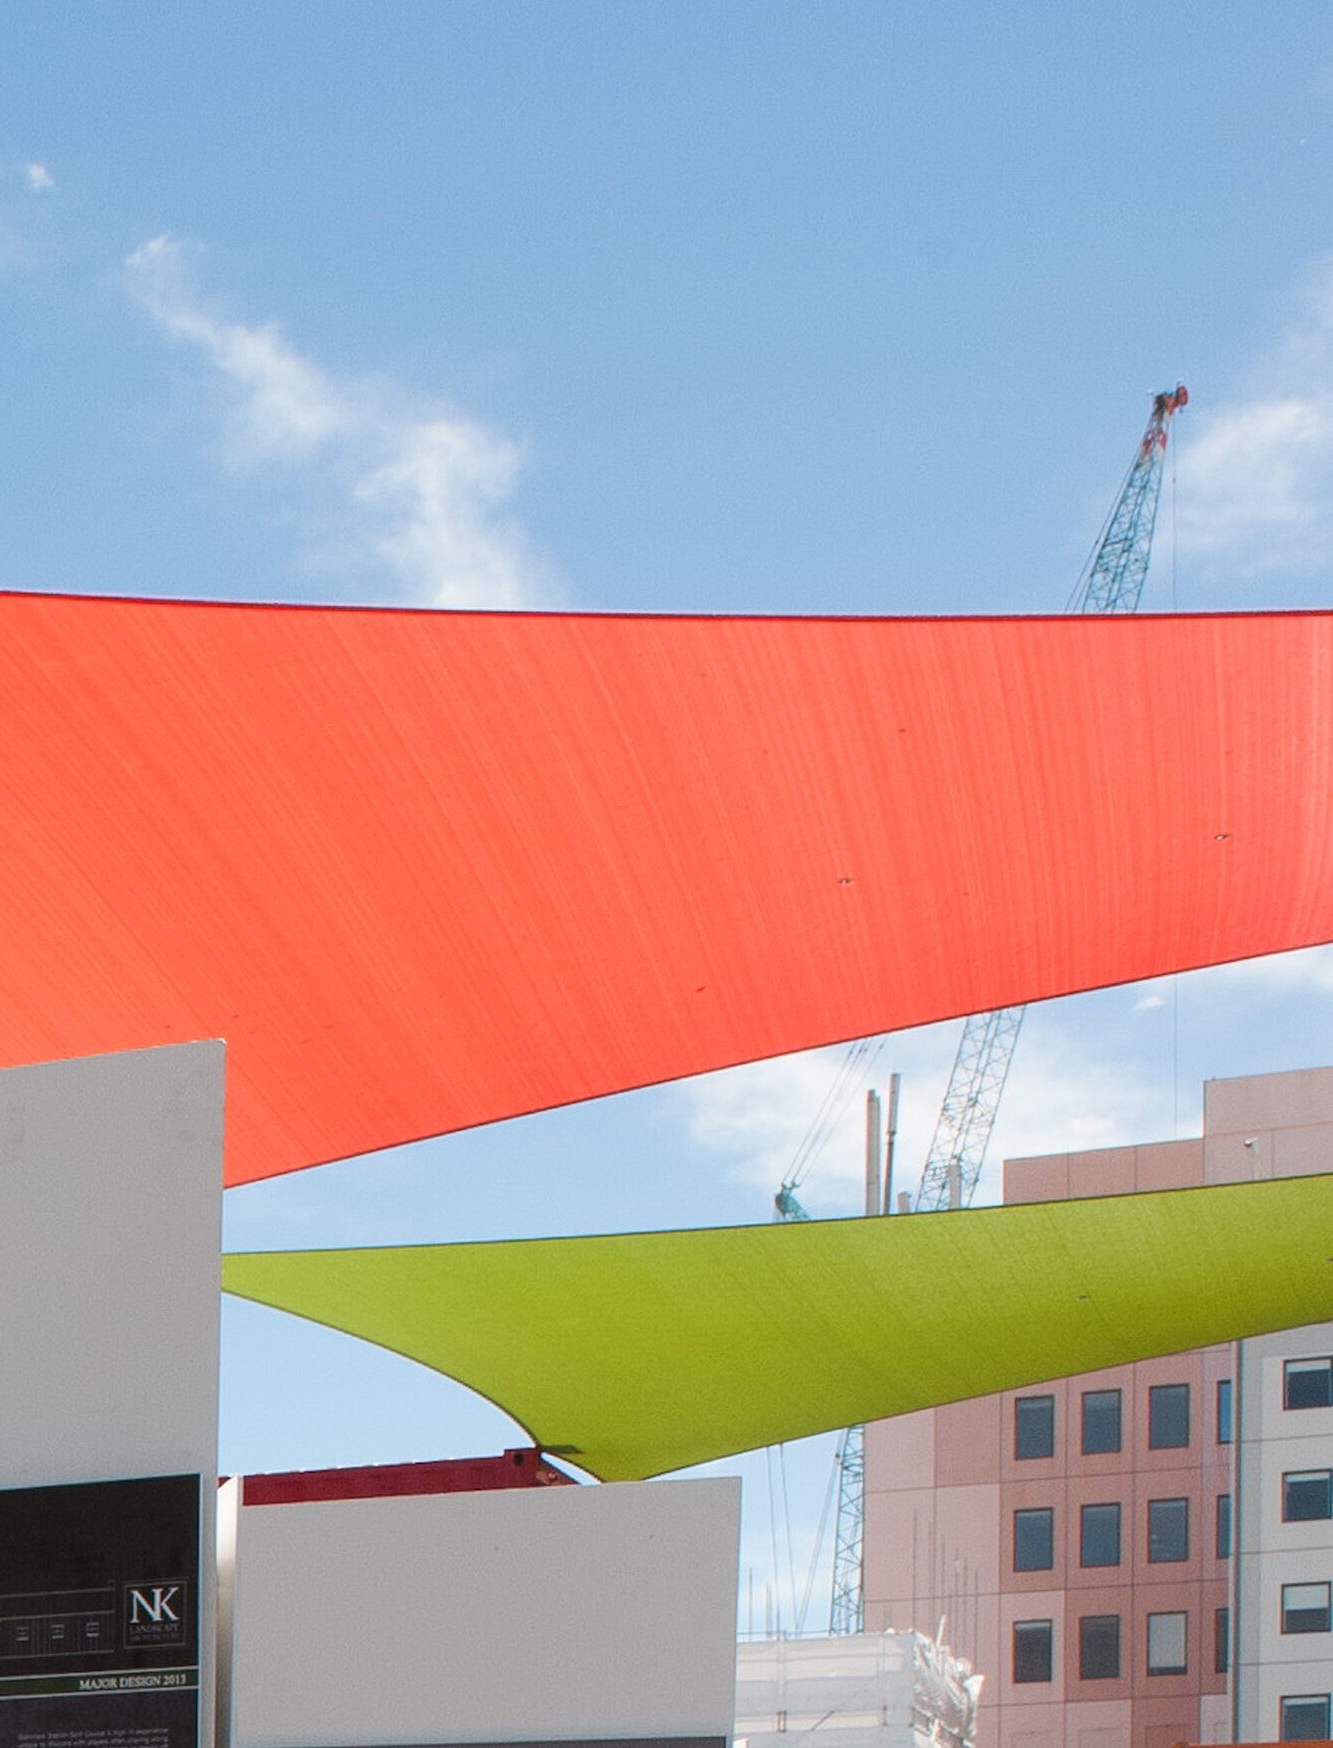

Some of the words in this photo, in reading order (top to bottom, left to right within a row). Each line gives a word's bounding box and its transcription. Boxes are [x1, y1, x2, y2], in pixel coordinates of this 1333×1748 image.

[130, 1587, 179, 1623] NK
[80, 1678, 116, 1690] MAJOR
[119, 1676, 160, 1688] DESIGN
[164, 1674, 185, 1685] 2013
